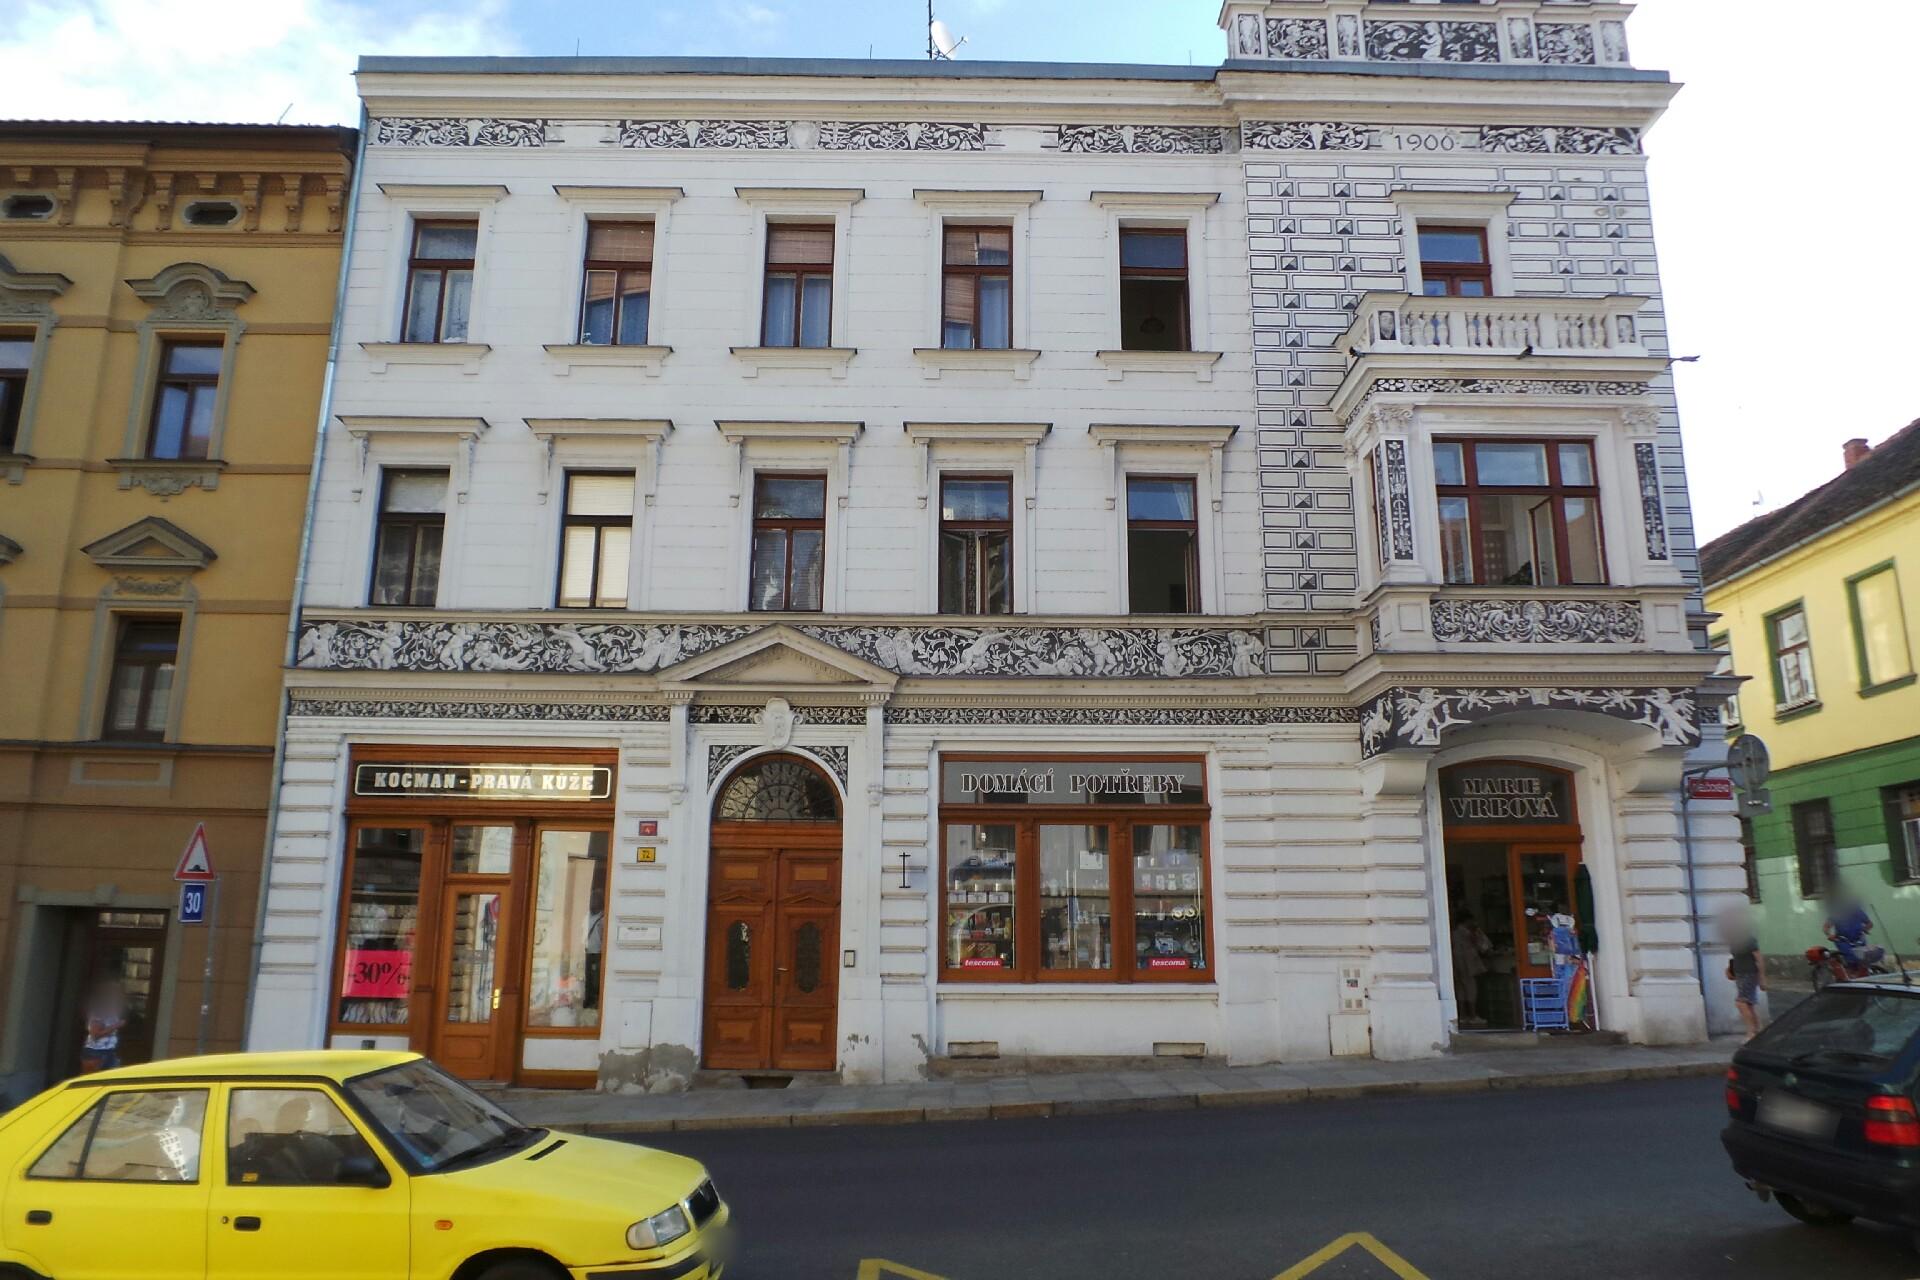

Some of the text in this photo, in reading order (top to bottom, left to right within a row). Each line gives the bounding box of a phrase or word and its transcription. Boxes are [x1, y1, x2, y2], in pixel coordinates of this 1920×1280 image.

[1394, 134, 1455, 151] 1900
[374, 772, 456, 789] KOCMAN
[961, 768, 1185, 794] DOMÁCÍ POTŘEBY
[1462, 778, 1541, 795] MARIE
[1449, 792, 1558, 818] VRBOVÁ
[185, 892, 201, 914] 30
